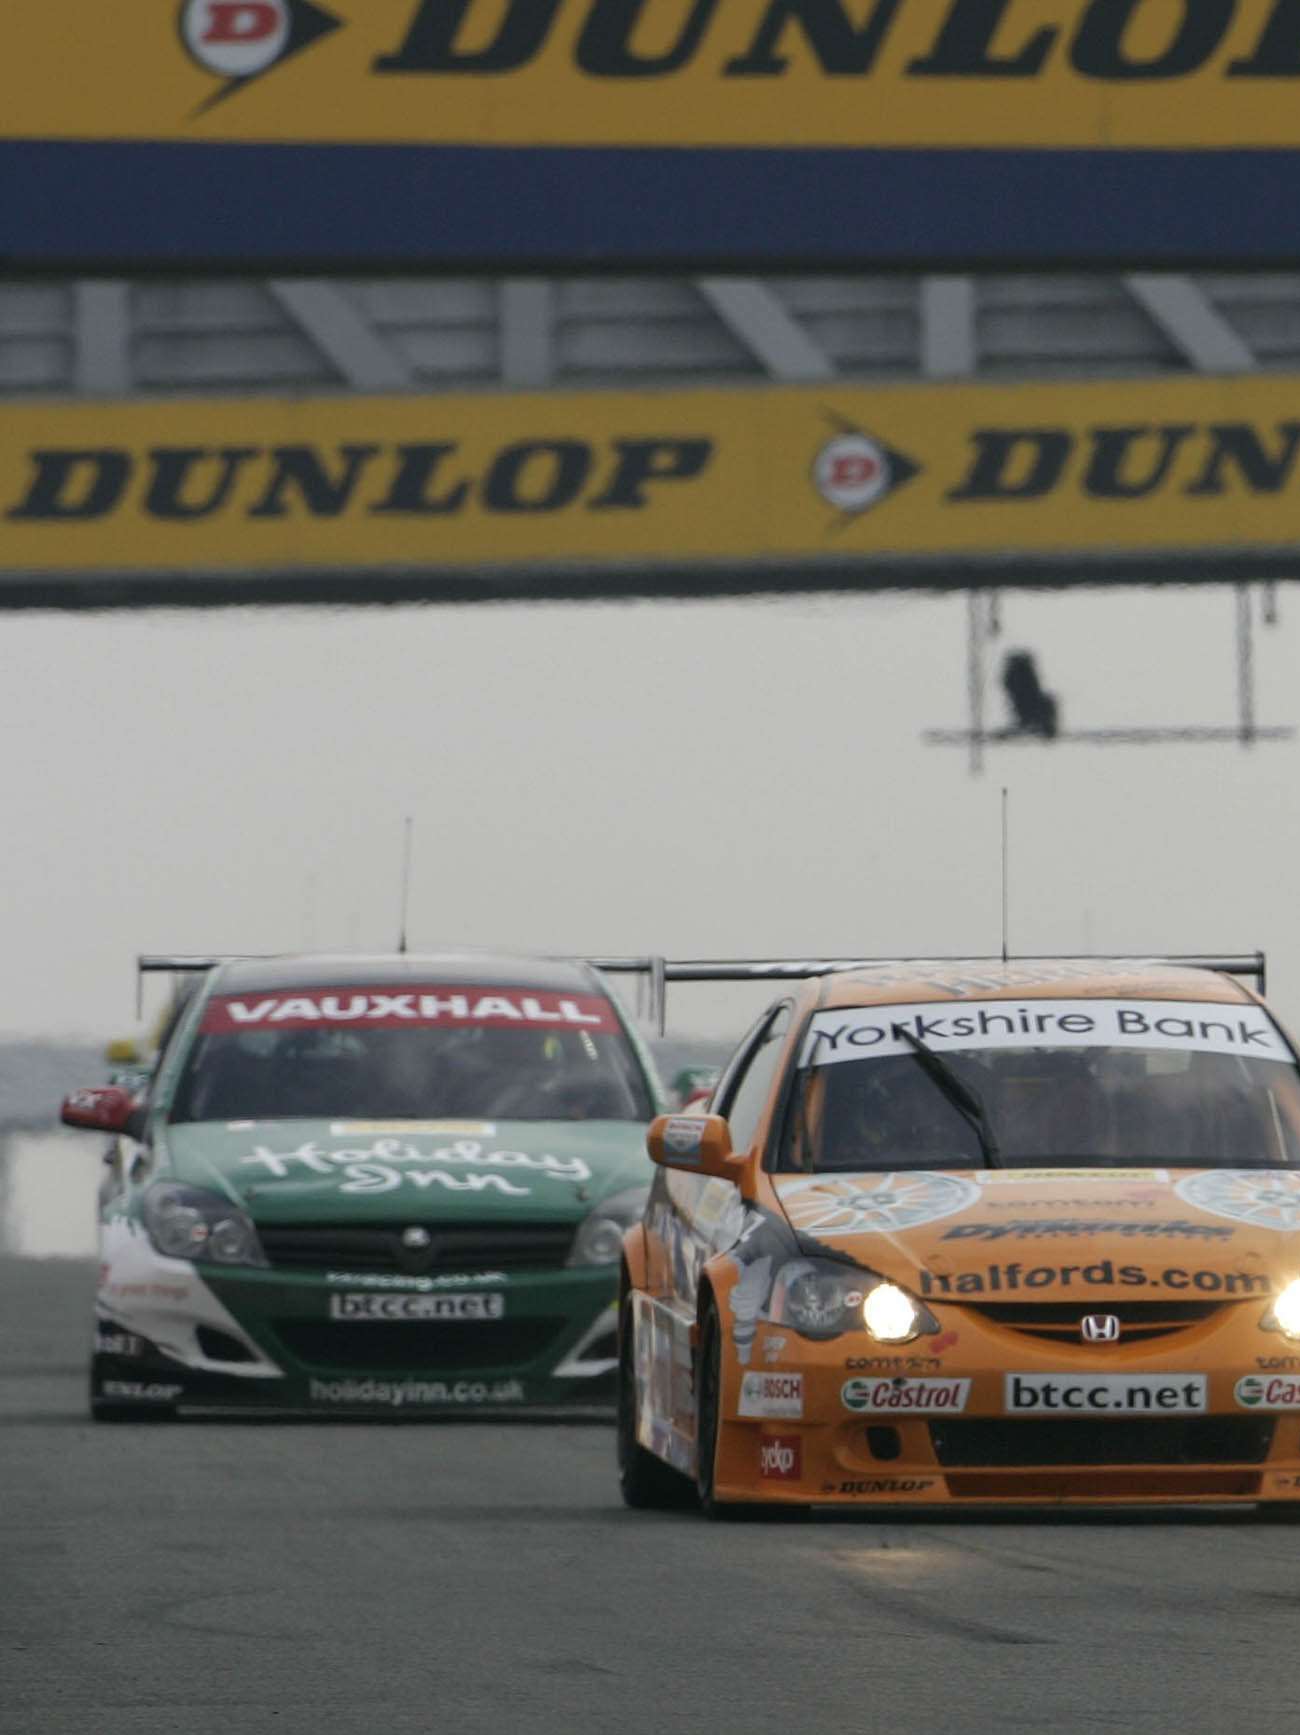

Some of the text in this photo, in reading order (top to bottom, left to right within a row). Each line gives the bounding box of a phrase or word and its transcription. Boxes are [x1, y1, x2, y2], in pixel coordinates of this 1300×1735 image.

[7, 438, 714, 521] DUNLOP
[226, 994, 602, 1024] VAUXHALL
[818, 1006, 1273, 1050] Yorkshire Bank
[240, 1138, 592, 1180] Holiday
[339, 1163, 531, 1195] Inn
[919, 1259, 1272, 1295] halfords.com
[309, 1376, 525, 1406] holidayinn.co.uk
[870, 1382, 961, 1409] Castrol
[1012, 1377, 1201, 1409] btcc.net
